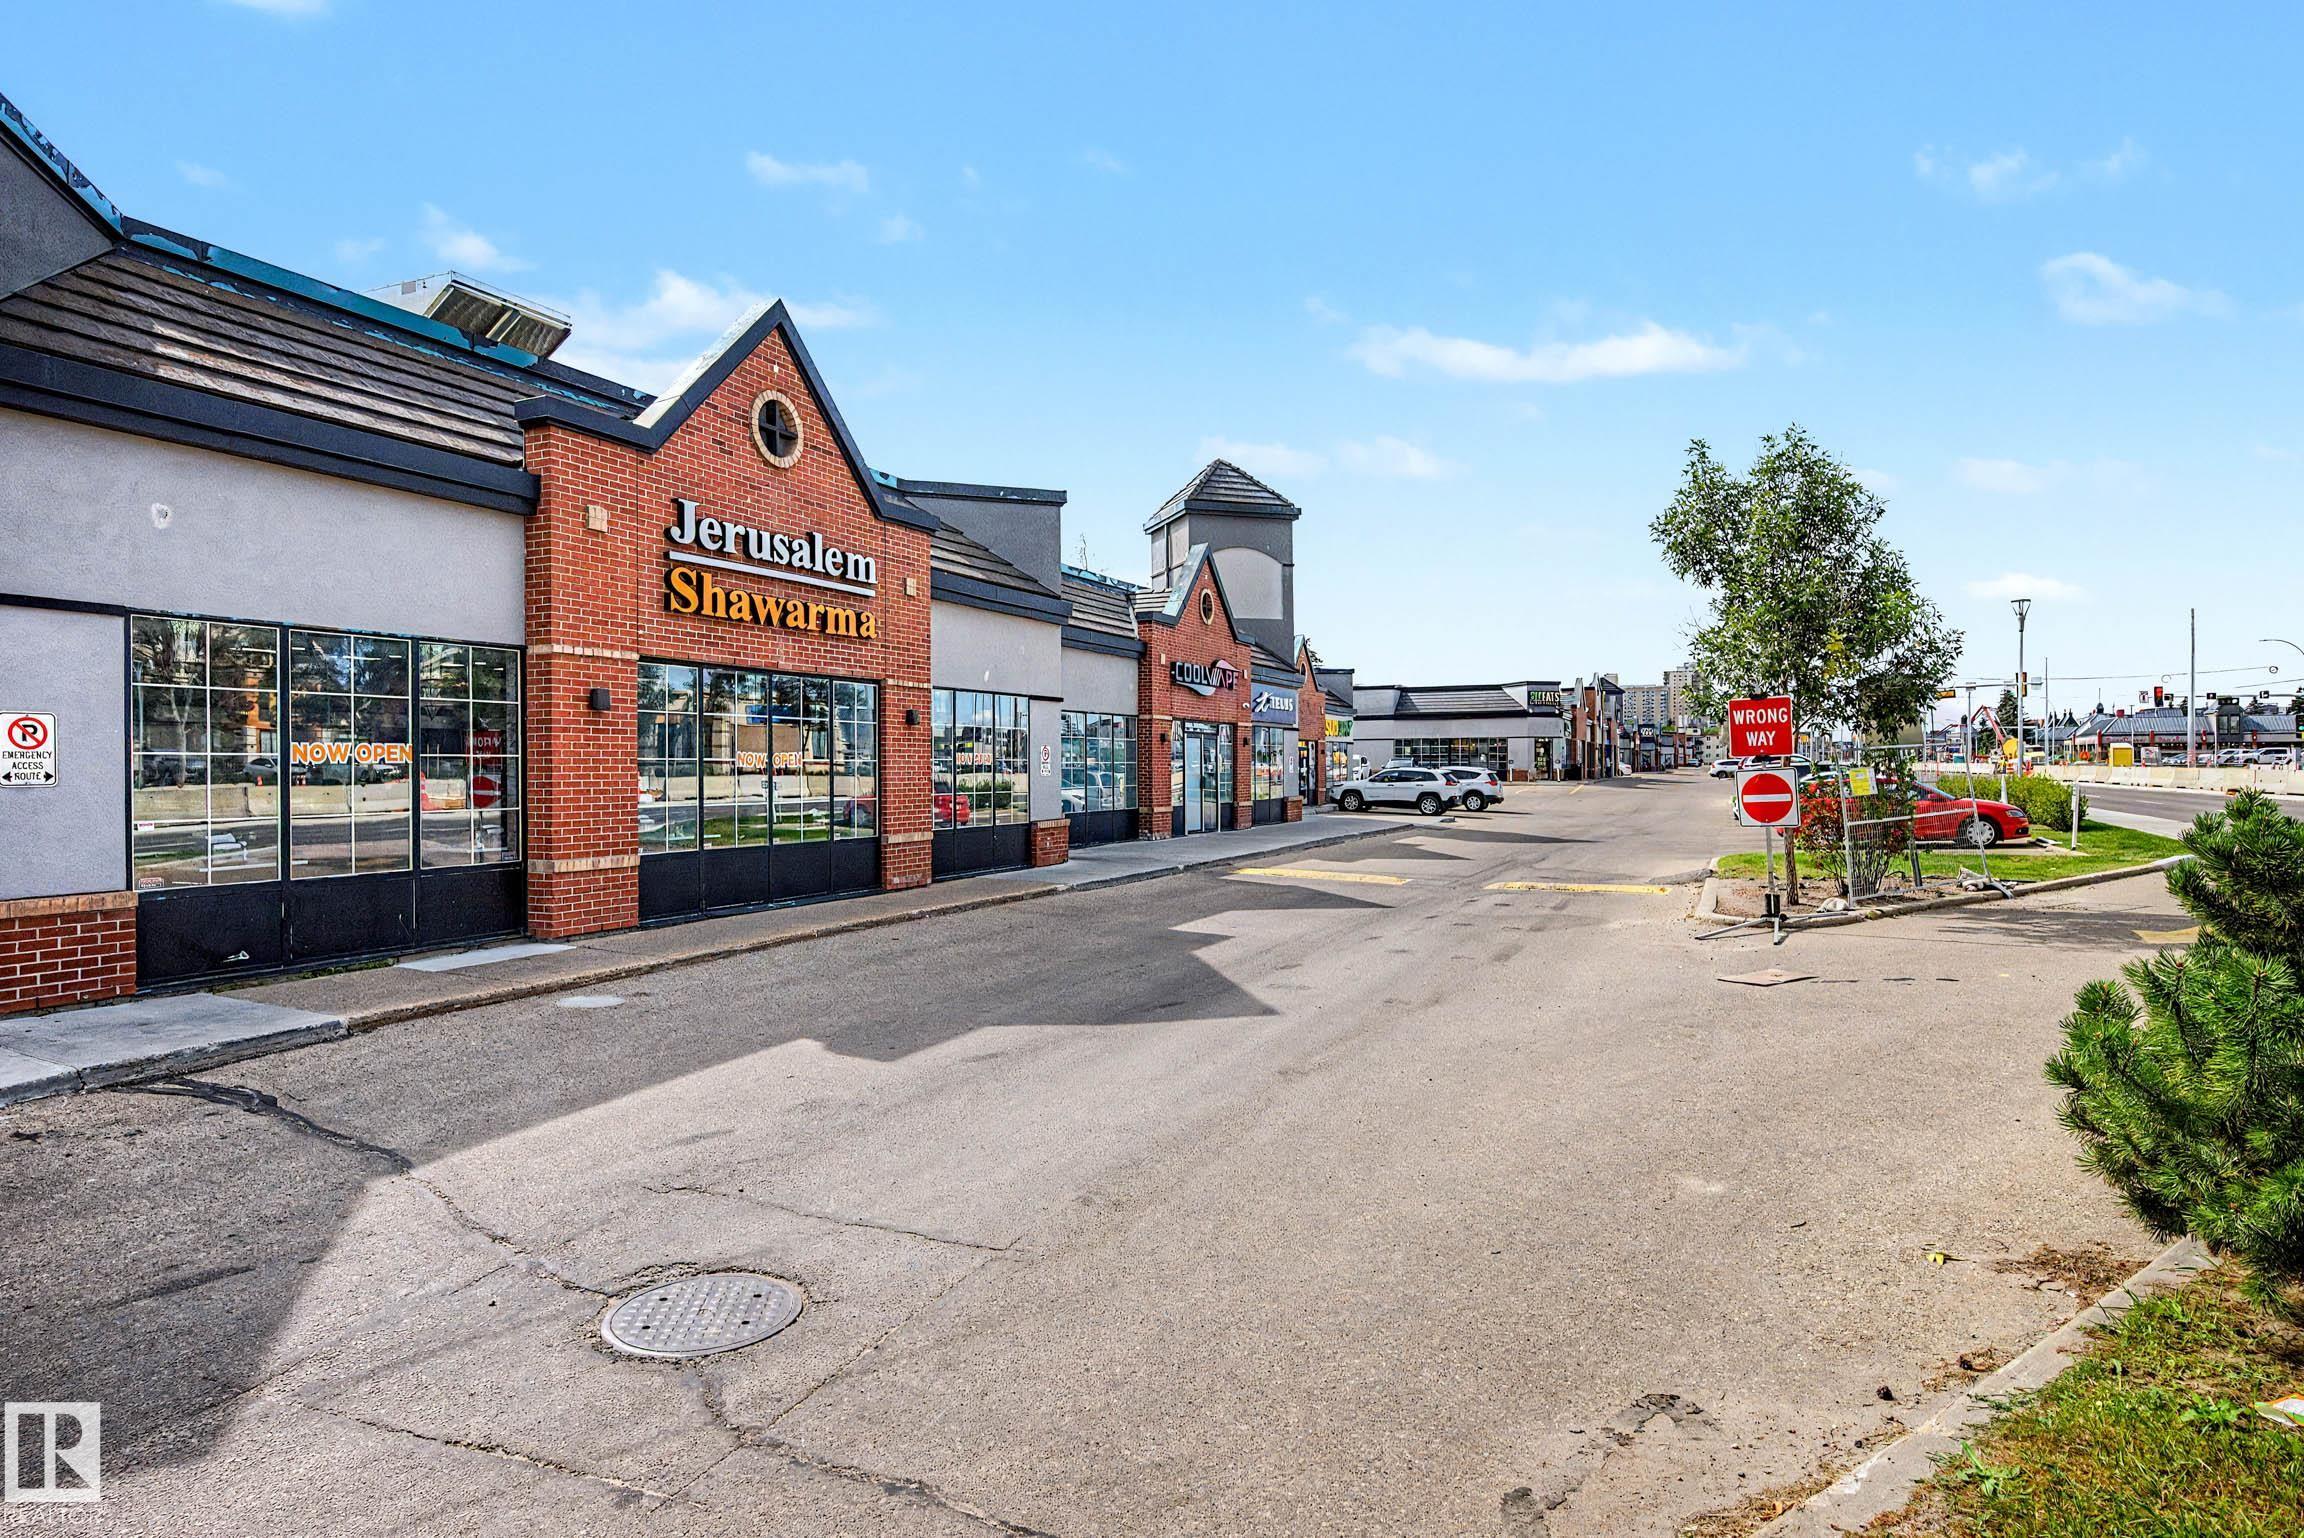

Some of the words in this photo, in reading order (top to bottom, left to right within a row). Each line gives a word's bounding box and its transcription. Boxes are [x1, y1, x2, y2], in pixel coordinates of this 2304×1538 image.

[669, 498, 878, 584] Jerusalem
[669, 567, 878, 639] Shawarma
[1269, 695, 1294, 712] TELUS
[1733, 707, 1788, 725] WRONG
[1746, 730, 1776, 747] WAY
[2, 750, 53, 760] EMERGENCY
[291, 741, 352, 765] NOW
[354, 742, 413, 764] OPEN
[736, 751, 767, 768] NOW
[773, 751, 802, 768] OPEN
[12, 761, 44, 770] ACCESS
[14, 772, 42, 781] ROUTE
